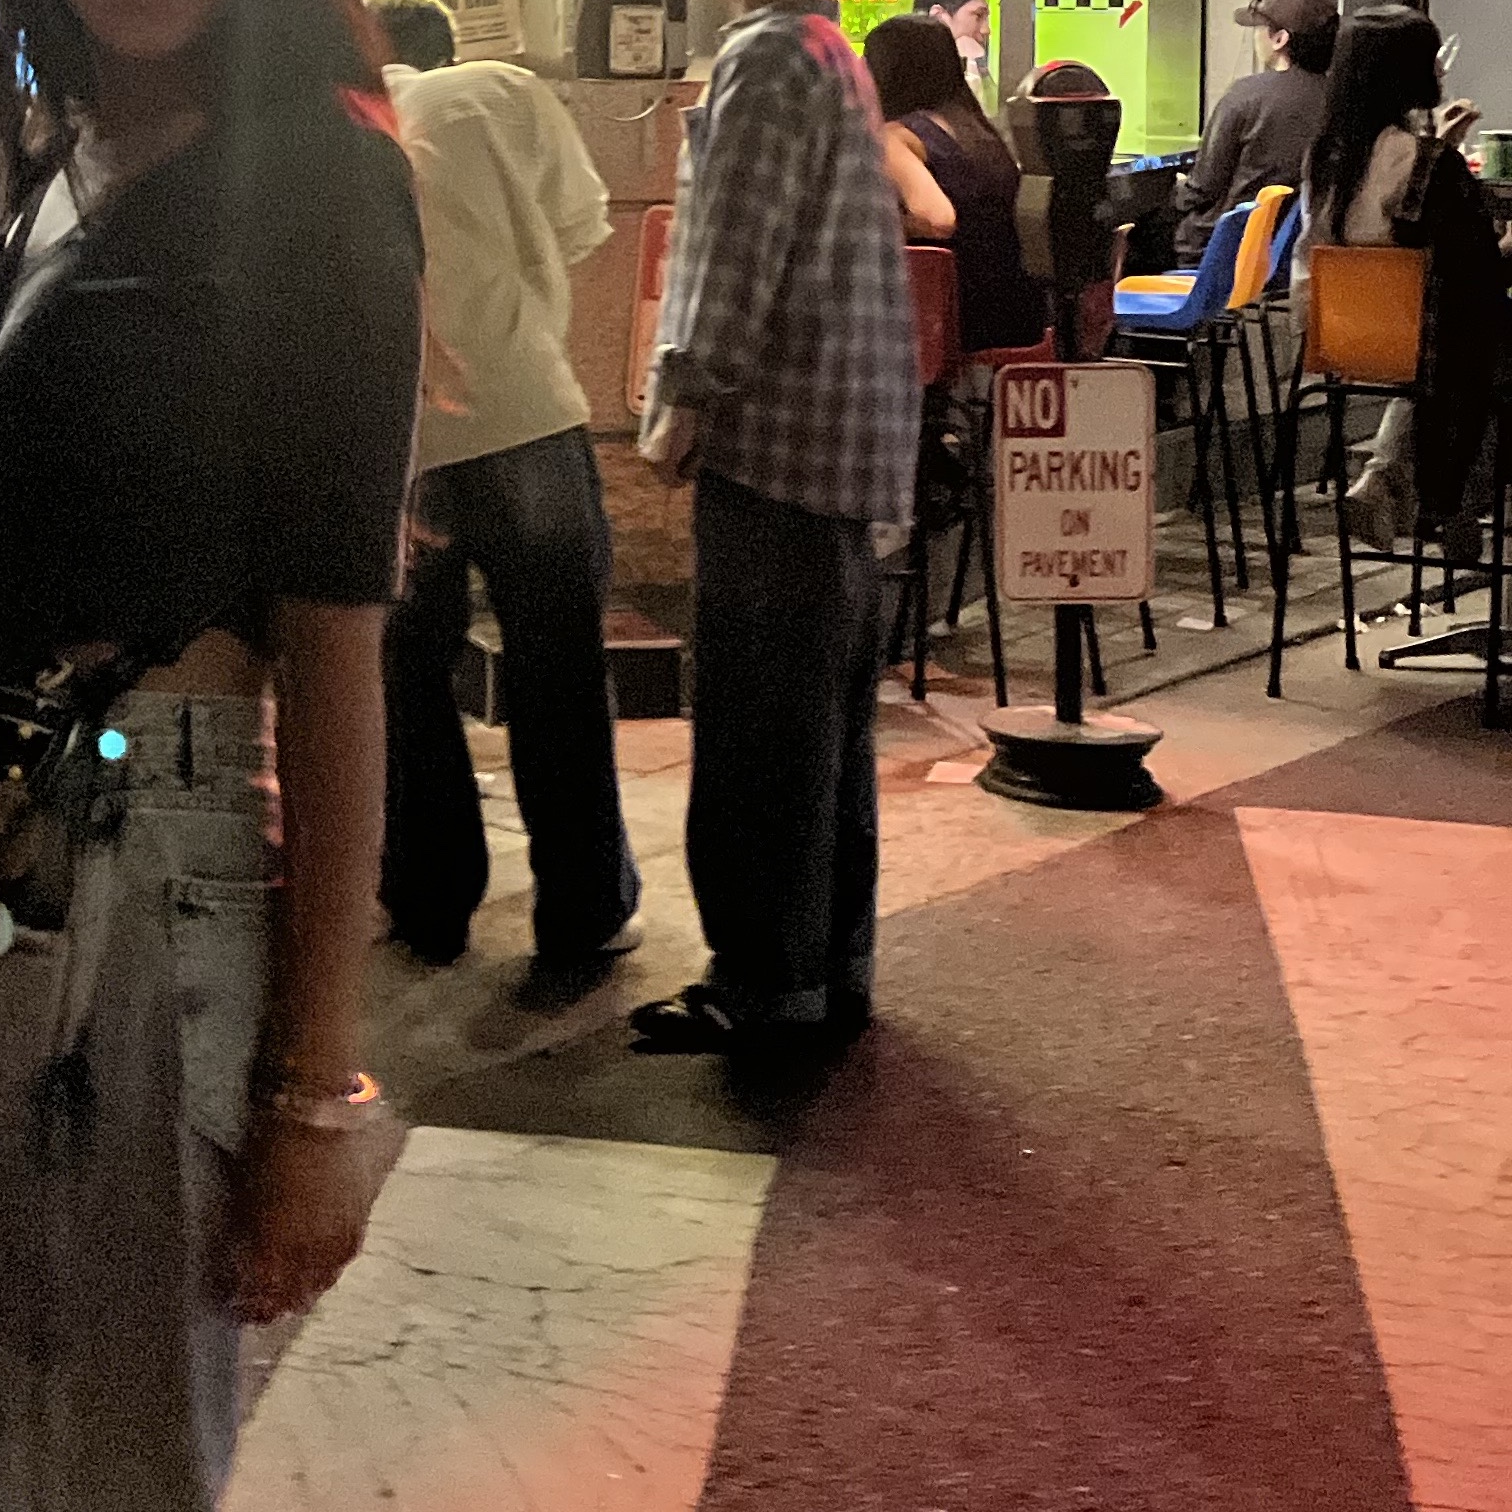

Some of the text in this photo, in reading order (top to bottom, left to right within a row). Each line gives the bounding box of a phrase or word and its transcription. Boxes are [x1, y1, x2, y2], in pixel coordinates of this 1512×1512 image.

[1006, 378, 1059, 430] NO
[1008, 450, 1141, 492] PARKING
[1019, 549, 1128, 578] PAVEMENT
